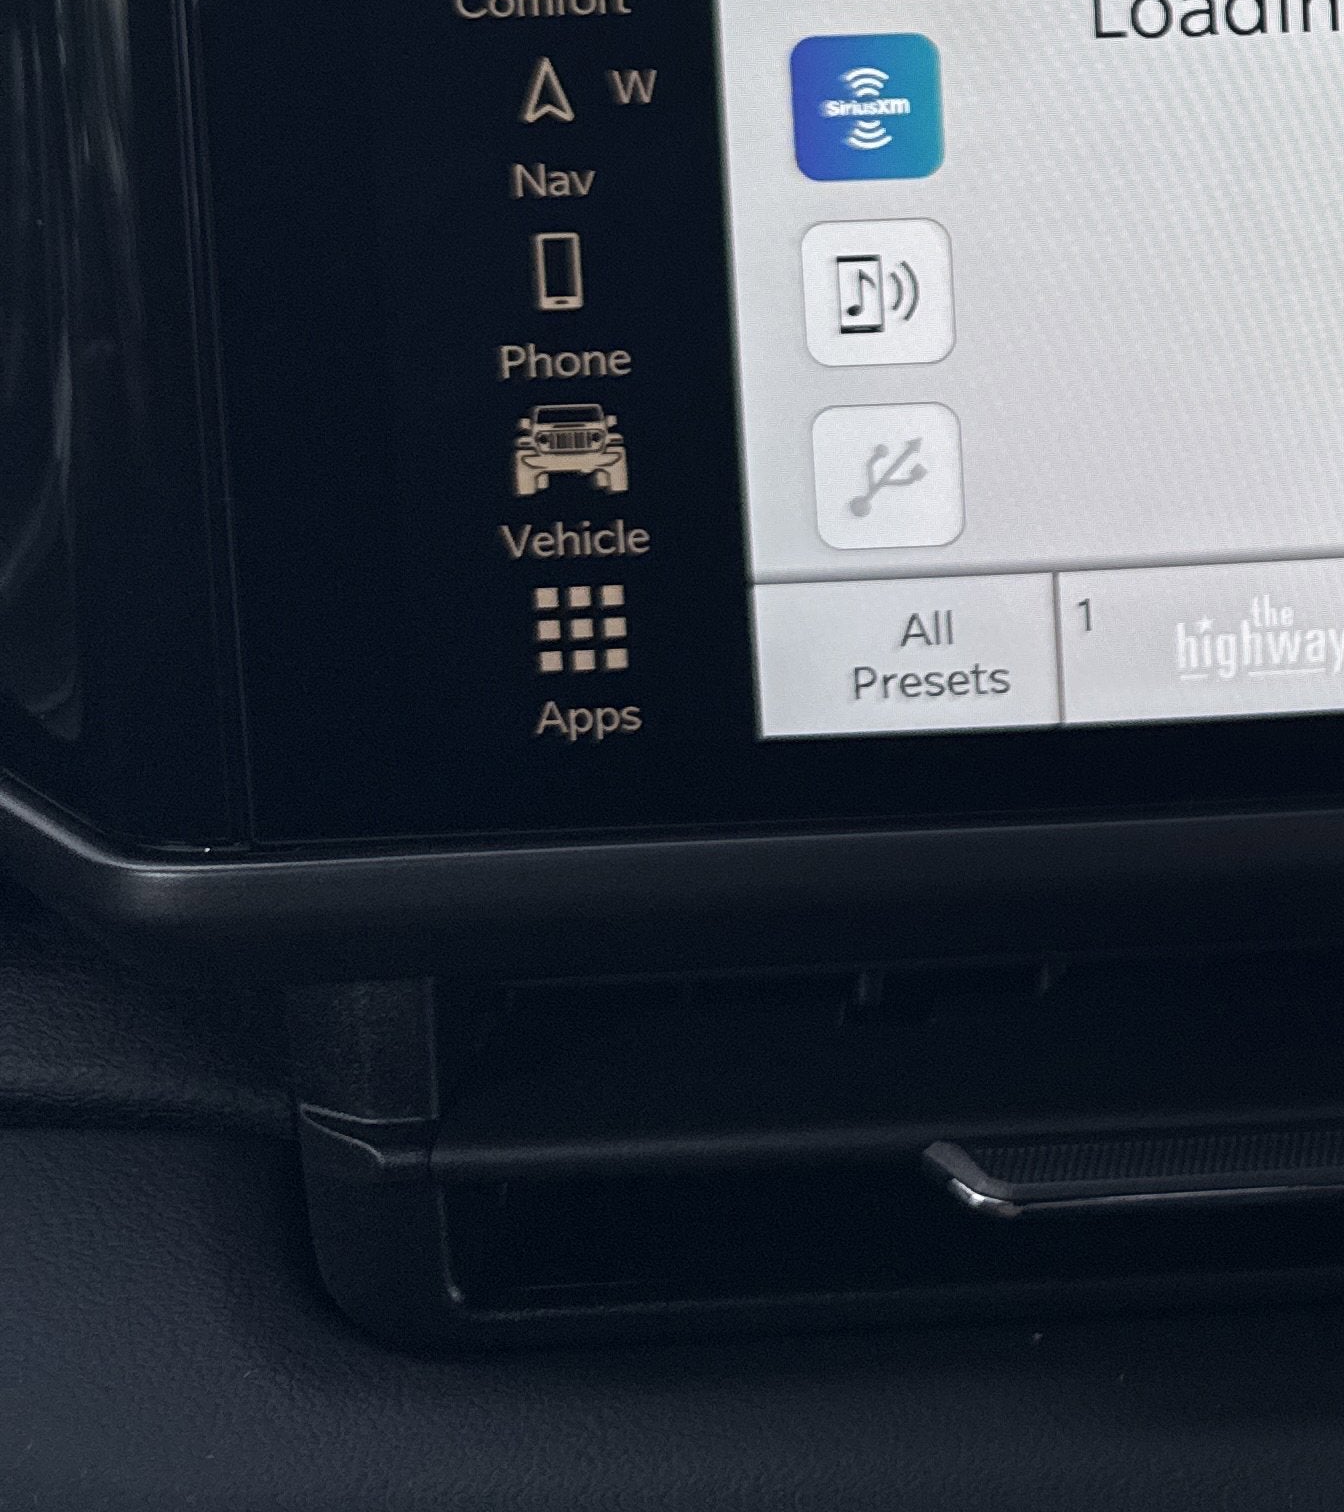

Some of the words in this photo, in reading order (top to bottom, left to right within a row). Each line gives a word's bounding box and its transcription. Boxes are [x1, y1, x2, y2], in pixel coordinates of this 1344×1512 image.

[607, 69, 658, 104] W
[511, 163, 596, 198] Nav
[500, 344, 632, 379] Phone
[500, 518, 651, 557] Vehicle
[900, 609, 954, 647] All
[1078, 597, 1092, 631] 1
[1250, 594, 1295, 628] the
[853, 663, 1012, 700] Presets
[535, 701, 643, 741] Apps
